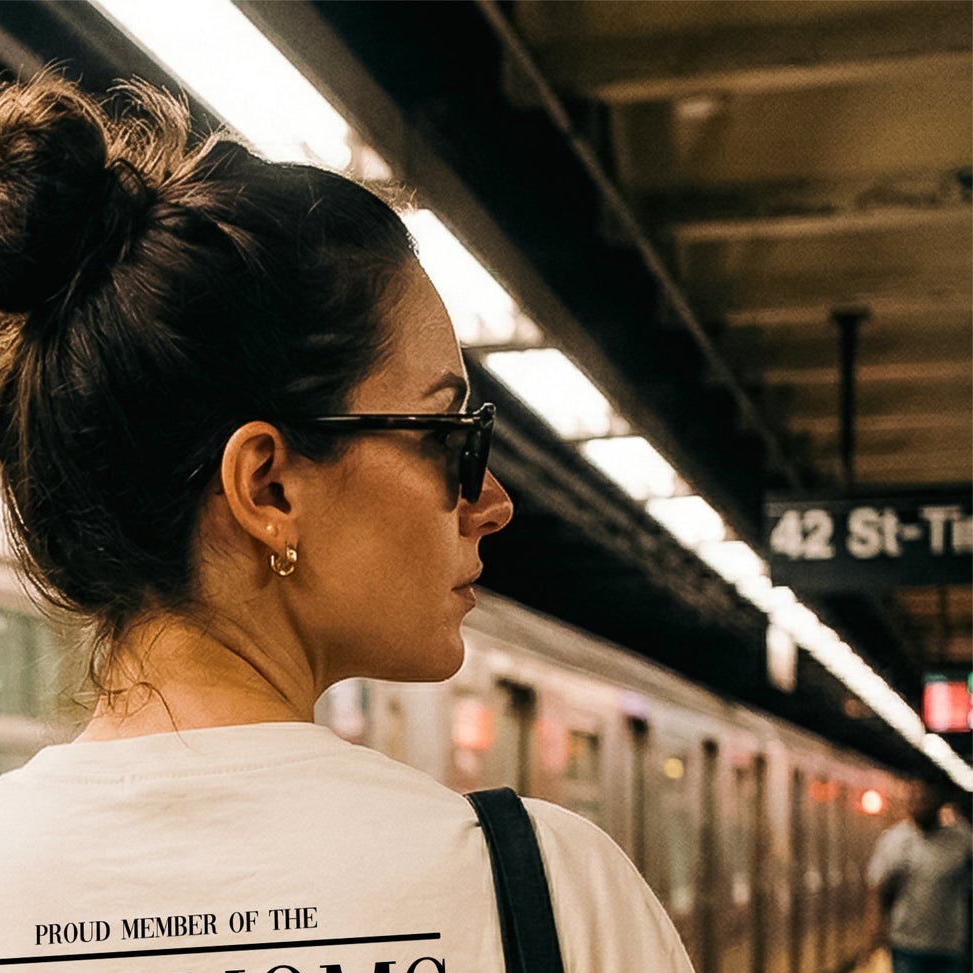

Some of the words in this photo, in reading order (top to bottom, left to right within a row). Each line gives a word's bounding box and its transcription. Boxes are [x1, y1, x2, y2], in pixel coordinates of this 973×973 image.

[770, 508, 835, 560] 42
[35, 921, 112, 946] PROUD
[121, 913, 218, 941] MEMBER
[229, 911, 257, 934] OF
[268, 906, 319, 931] THE
